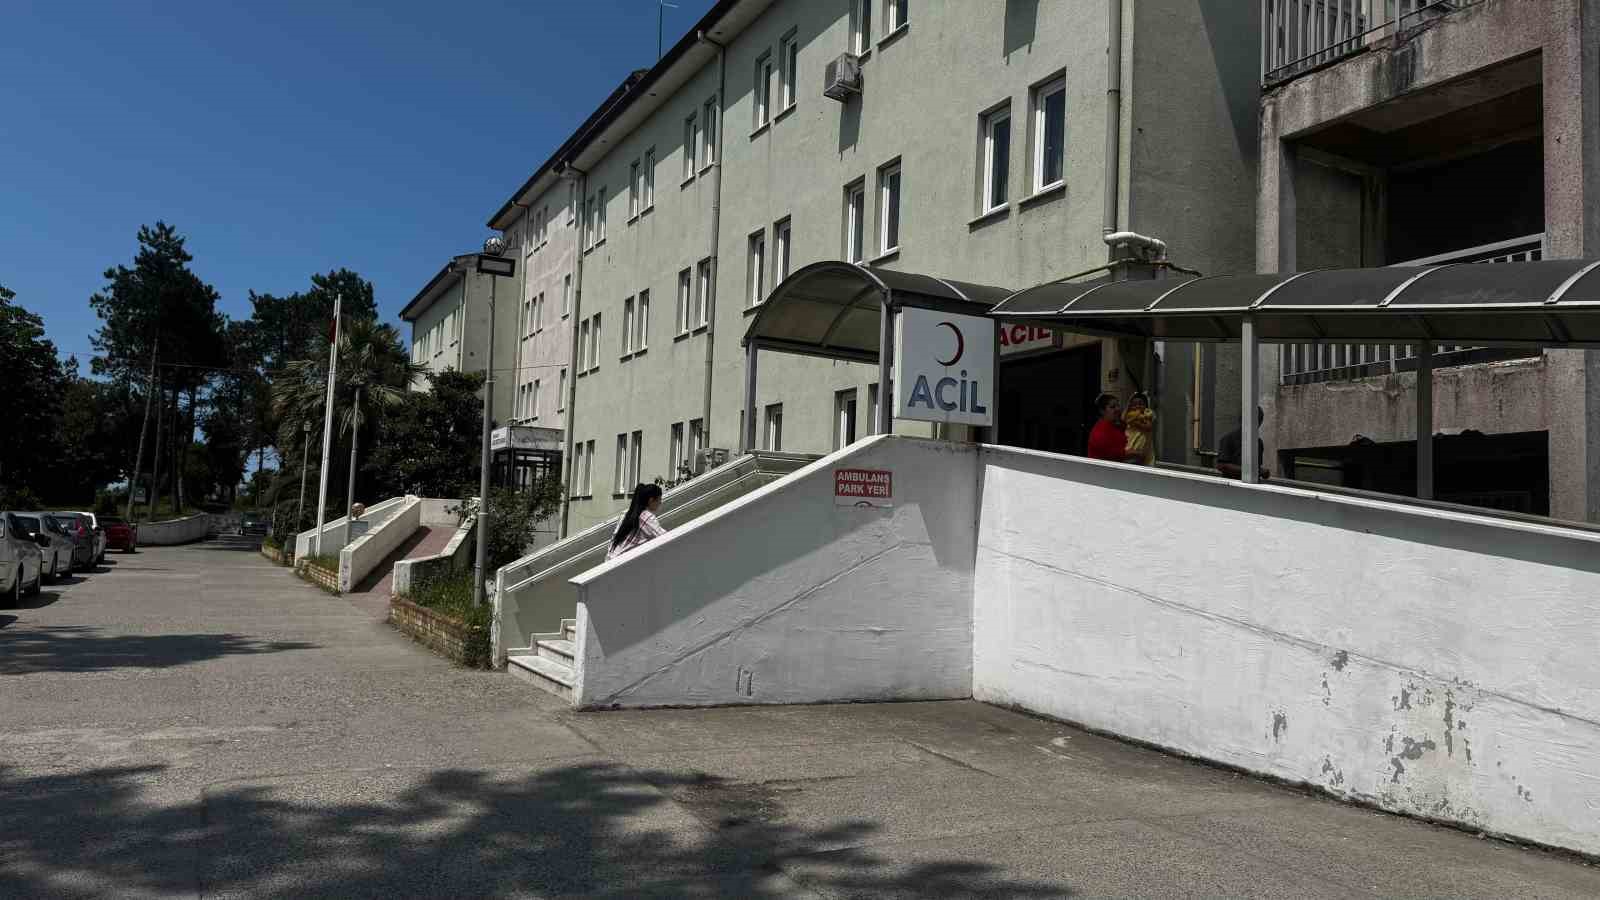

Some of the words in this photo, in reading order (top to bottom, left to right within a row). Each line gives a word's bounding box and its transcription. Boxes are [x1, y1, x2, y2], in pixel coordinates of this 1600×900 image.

[907, 369, 986, 413] ACİL
[838, 471, 889, 483] AMBULANS
[839, 483, 864, 494] PARK
